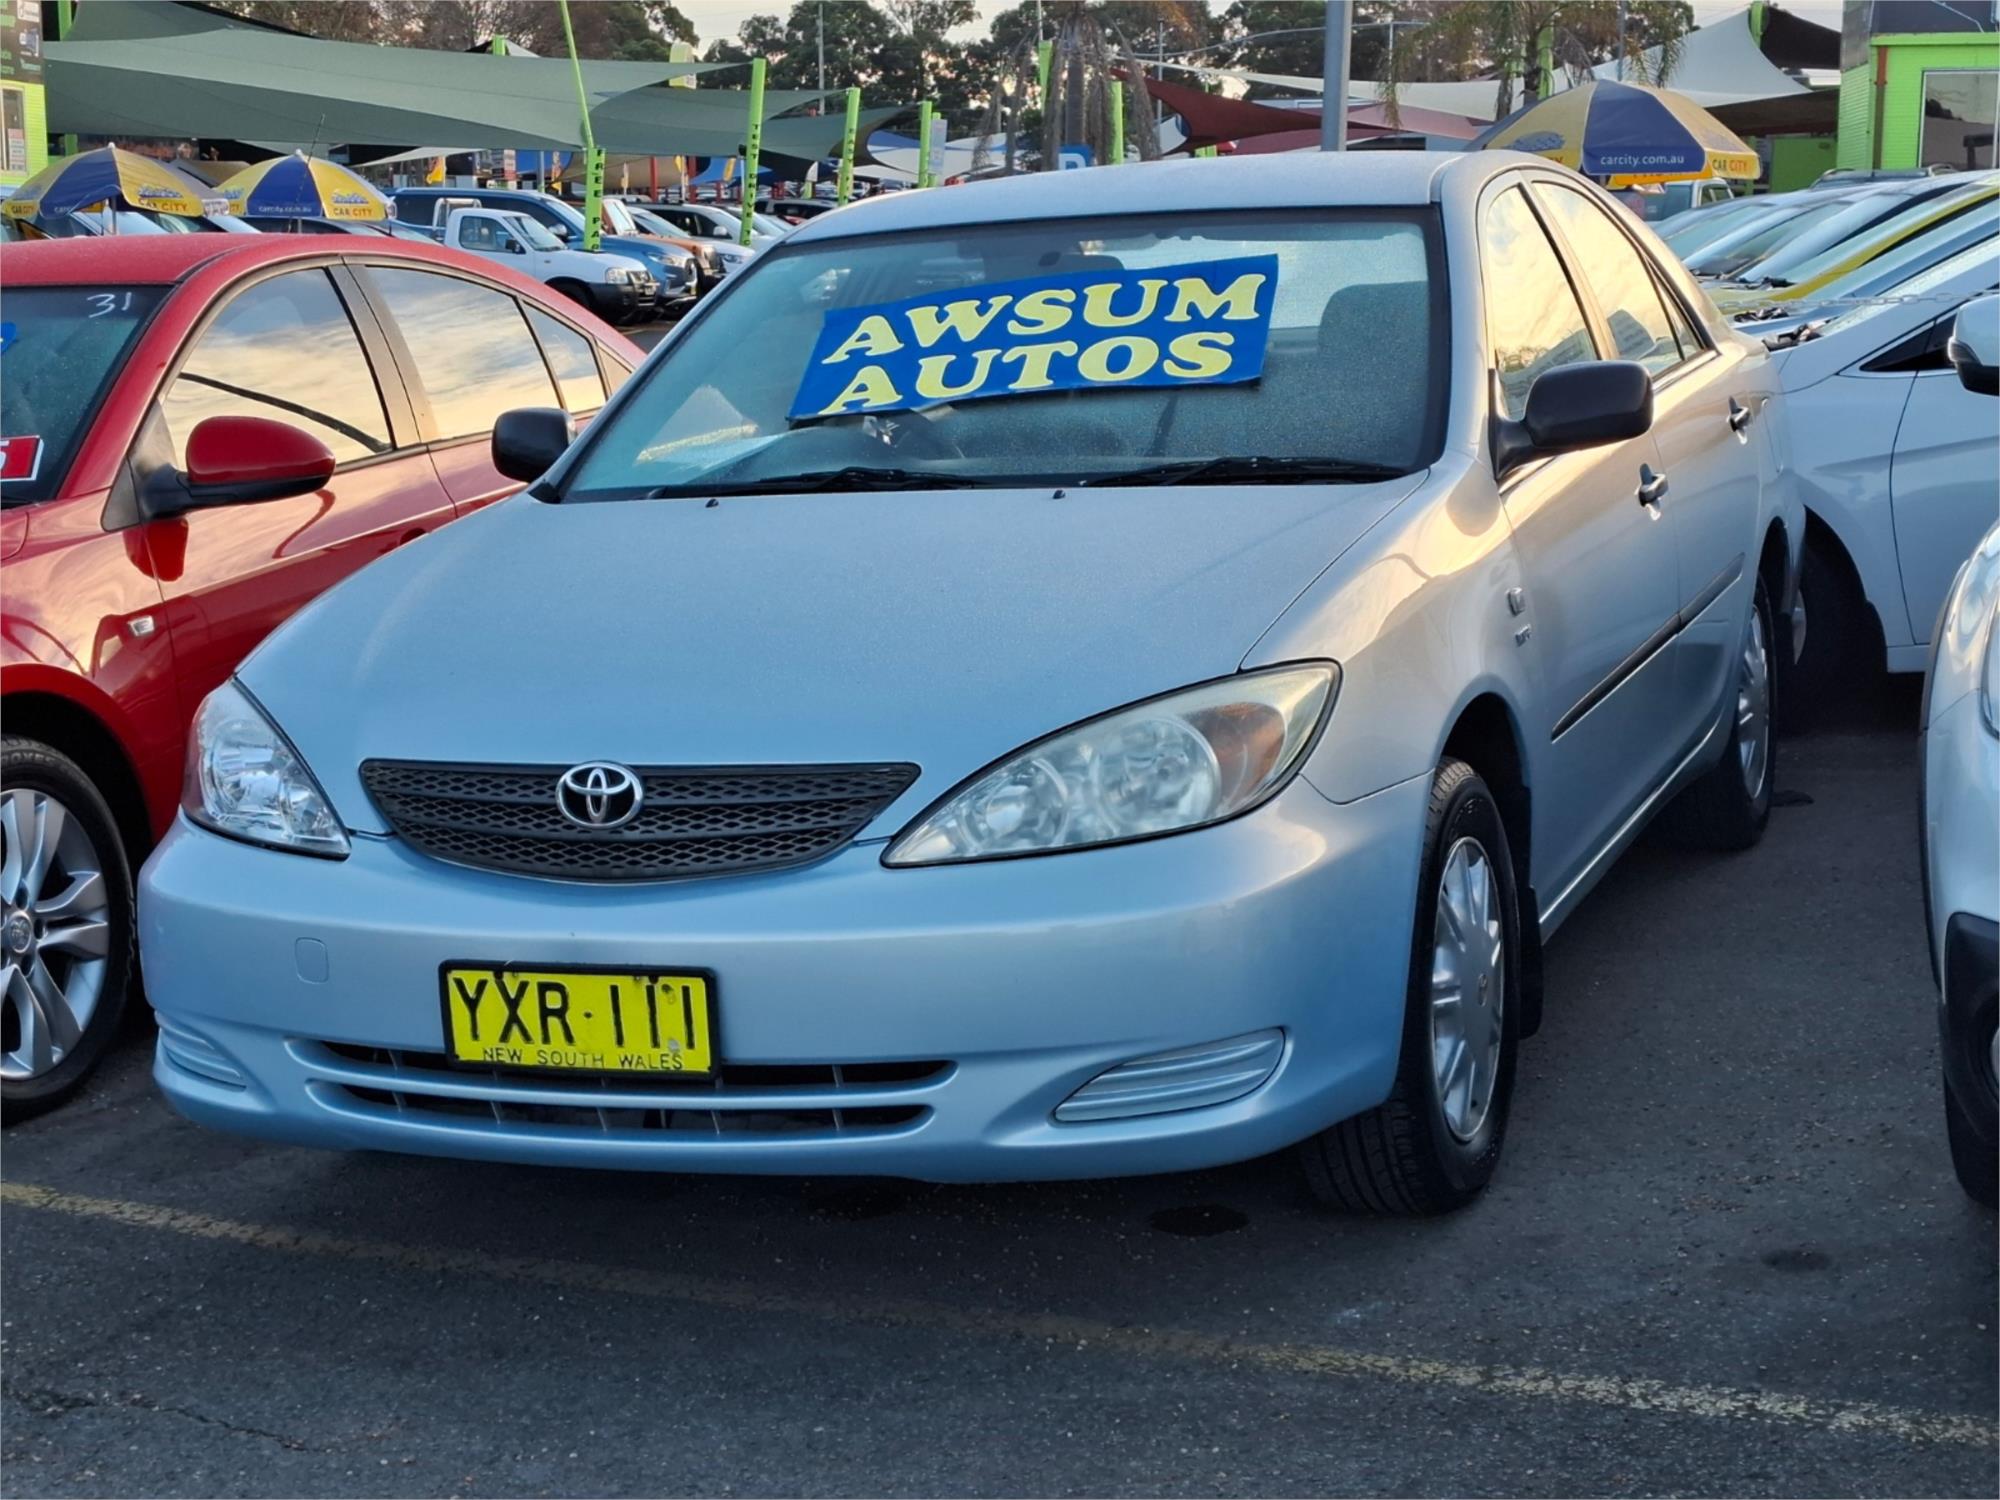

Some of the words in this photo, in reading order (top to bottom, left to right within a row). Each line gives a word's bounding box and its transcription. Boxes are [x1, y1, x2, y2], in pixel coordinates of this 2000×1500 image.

[1600, 154, 1685, 168] carcity.com.au
[1712, 158, 1728, 172] CAR
[1729, 158, 1748, 172] CITY
[593, 149, 603, 198] FREE
[161, 202, 188, 212] CITY
[333, 207, 350, 216] CAR
[352, 208, 372, 217] CITY
[87, 292, 132, 318] 31
[820, 273, 1266, 365] AWSUM
[817, 331, 1235, 416] AUTOS
[482, 1047, 523, 1063] NEW
[537, 1049, 605, 1069] SOUTH
[619, 1053, 684, 1070] WALES
